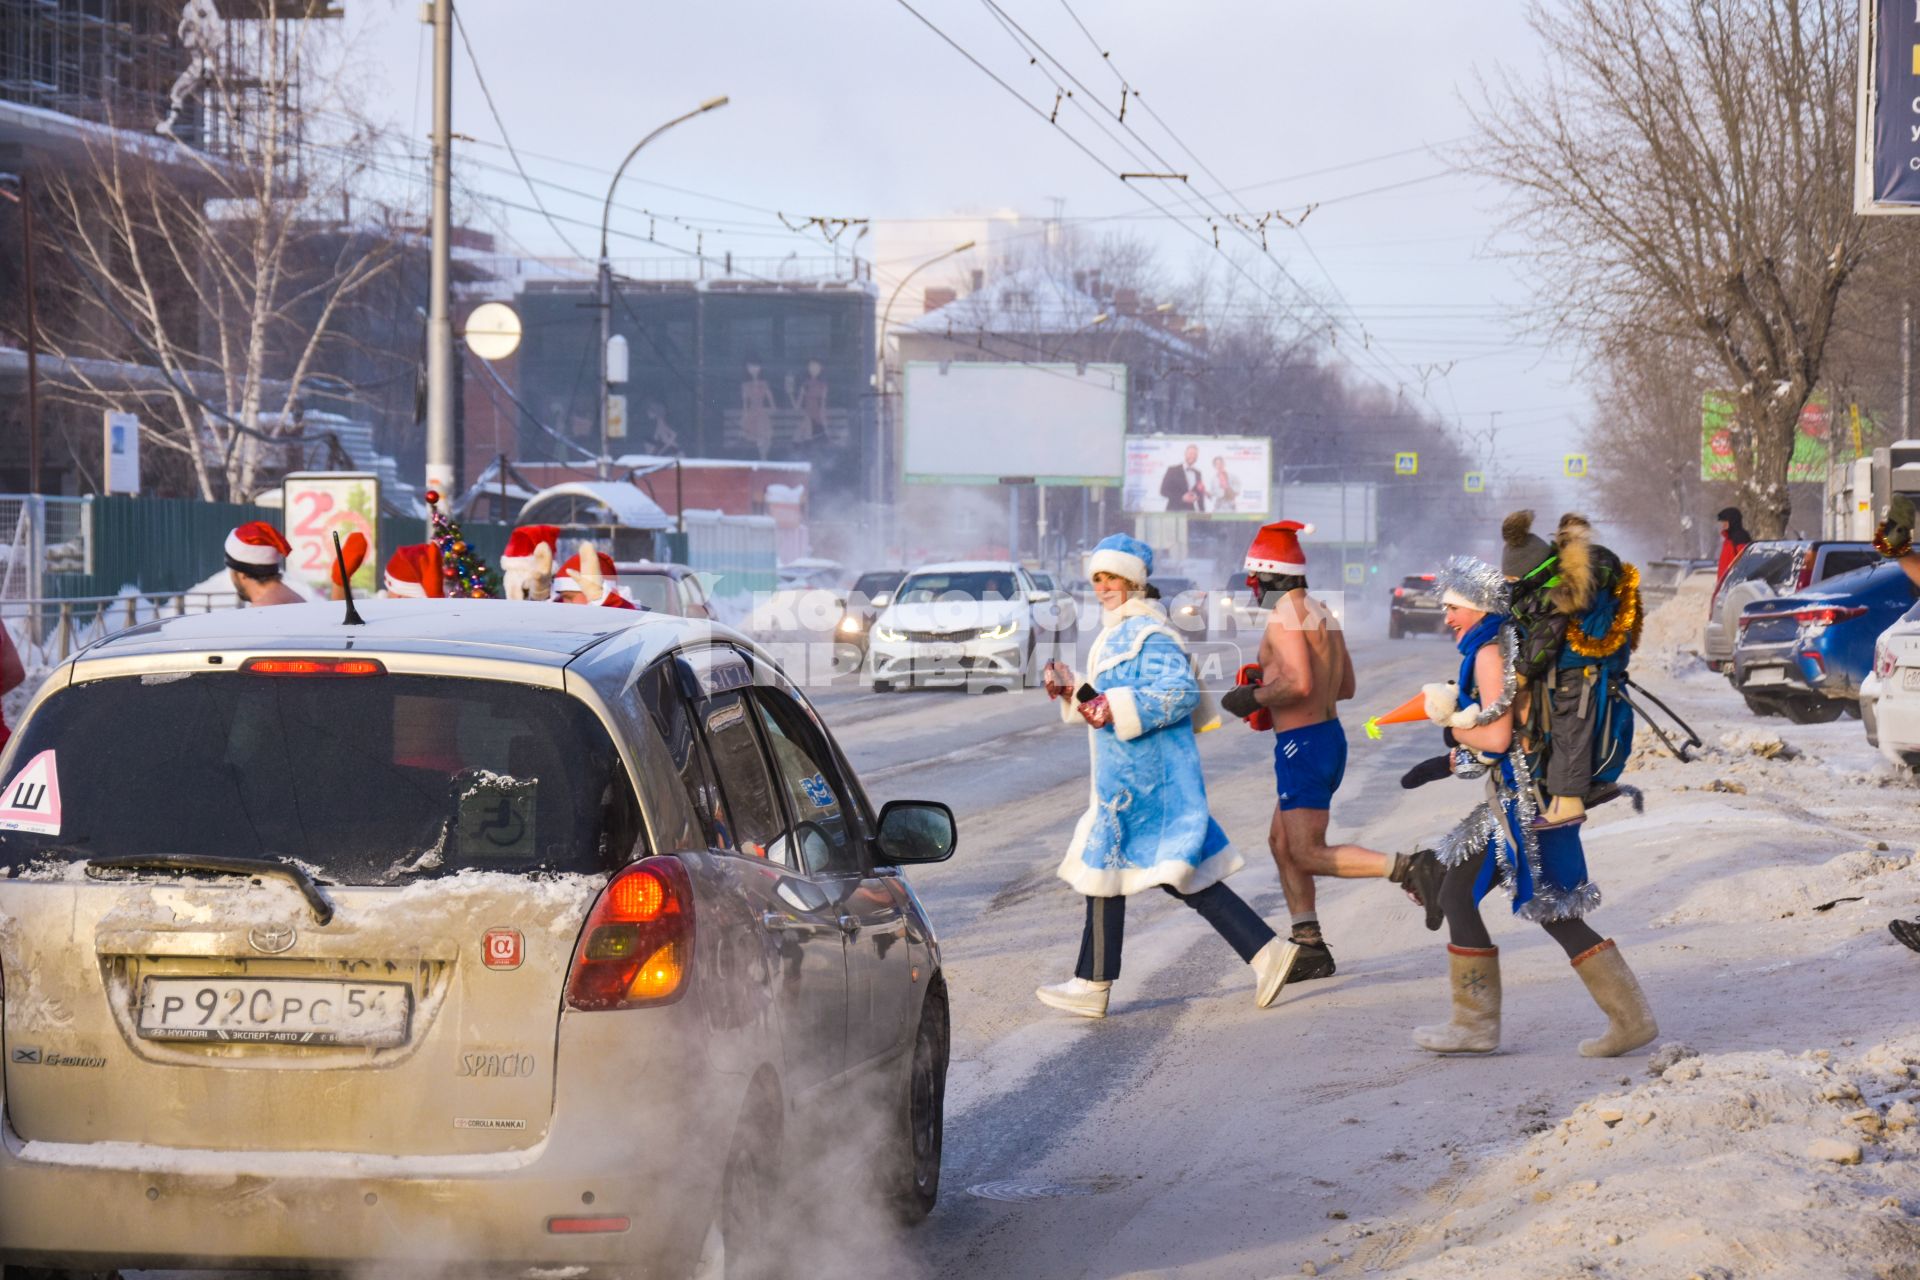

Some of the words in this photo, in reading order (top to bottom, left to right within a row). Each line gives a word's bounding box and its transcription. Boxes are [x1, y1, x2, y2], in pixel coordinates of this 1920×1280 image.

[11, 782, 46, 810] Ш
[168, 1029, 208, 1038] HYUNDAI
[232, 1031, 298, 1041] ЭКСПЕРТ-АВТО
[459, 1053, 535, 1078] SPACIO
[467, 1120, 494, 1128] COROLLA
